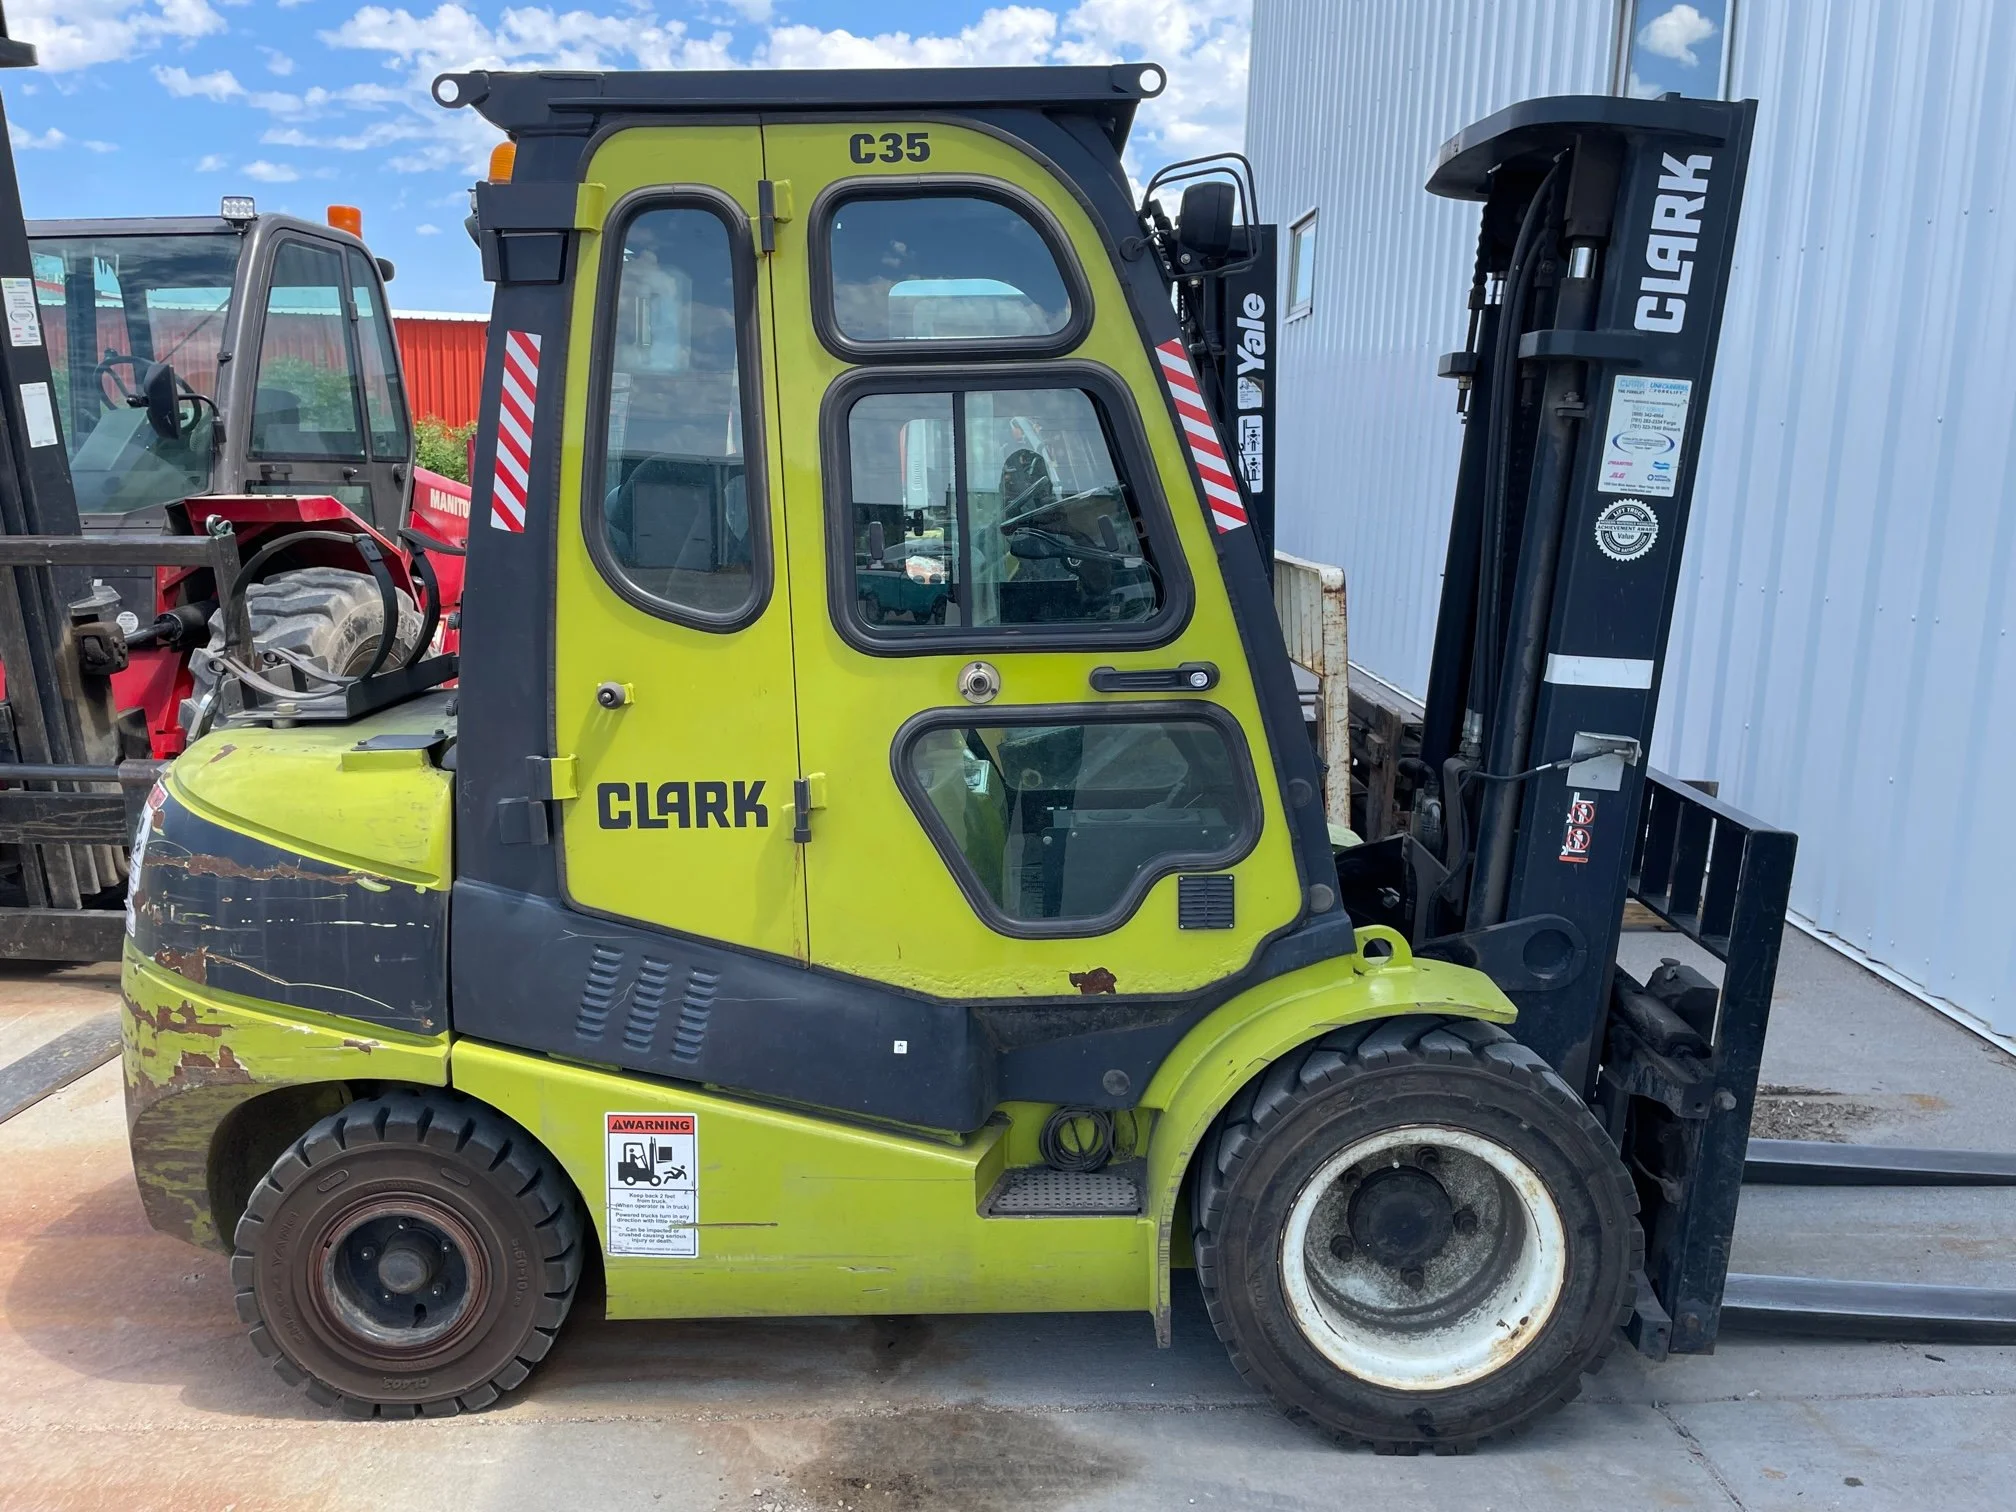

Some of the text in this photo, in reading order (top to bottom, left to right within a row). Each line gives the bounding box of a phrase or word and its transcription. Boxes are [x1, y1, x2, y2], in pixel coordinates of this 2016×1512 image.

[849, 132, 930, 163] C35
[1633, 151, 1713, 333] CLARK
[1236, 292, 1266, 375] Yale
[430, 487, 471, 519] MANITO
[1612, 507, 1646, 520] LIFT TRUCK
[597, 781, 768, 830] CLARK
[623, 1120, 690, 1130] WARNING
